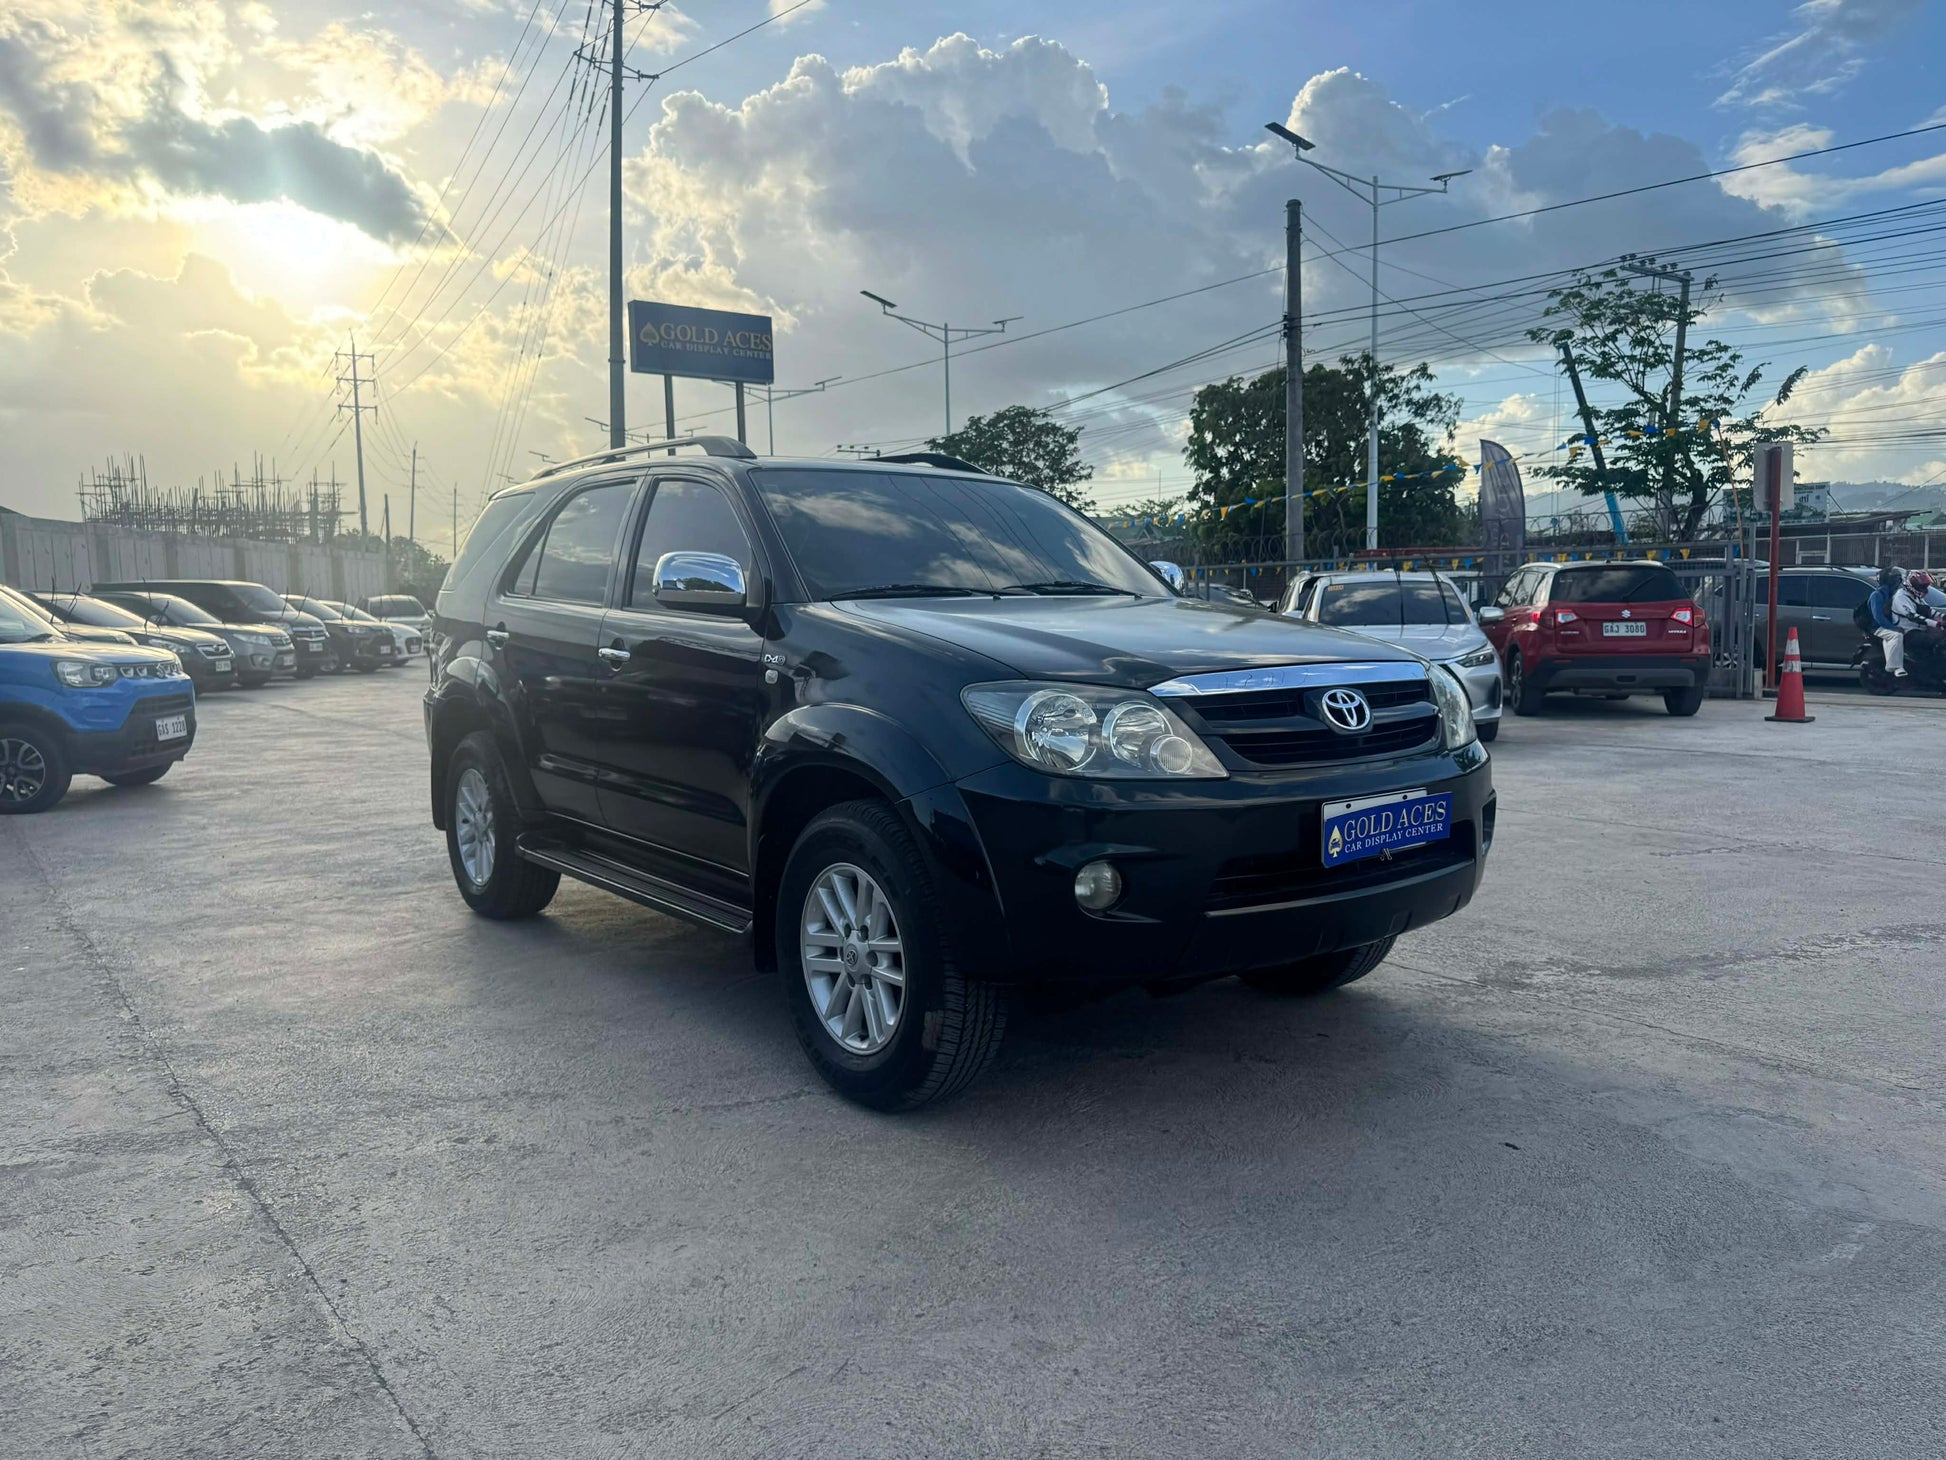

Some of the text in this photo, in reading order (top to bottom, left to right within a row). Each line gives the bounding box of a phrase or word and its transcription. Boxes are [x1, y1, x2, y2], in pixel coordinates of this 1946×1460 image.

[660, 322, 771, 350] GOLD ACES
[661, 341, 771, 360] CAR DISPLAY CENTER
[1604, 624, 1619, 634] GAJ
[1344, 801, 1446, 841] GOLD ACES
[1344, 823, 1443, 853] CAR DISPLAY CENTER
